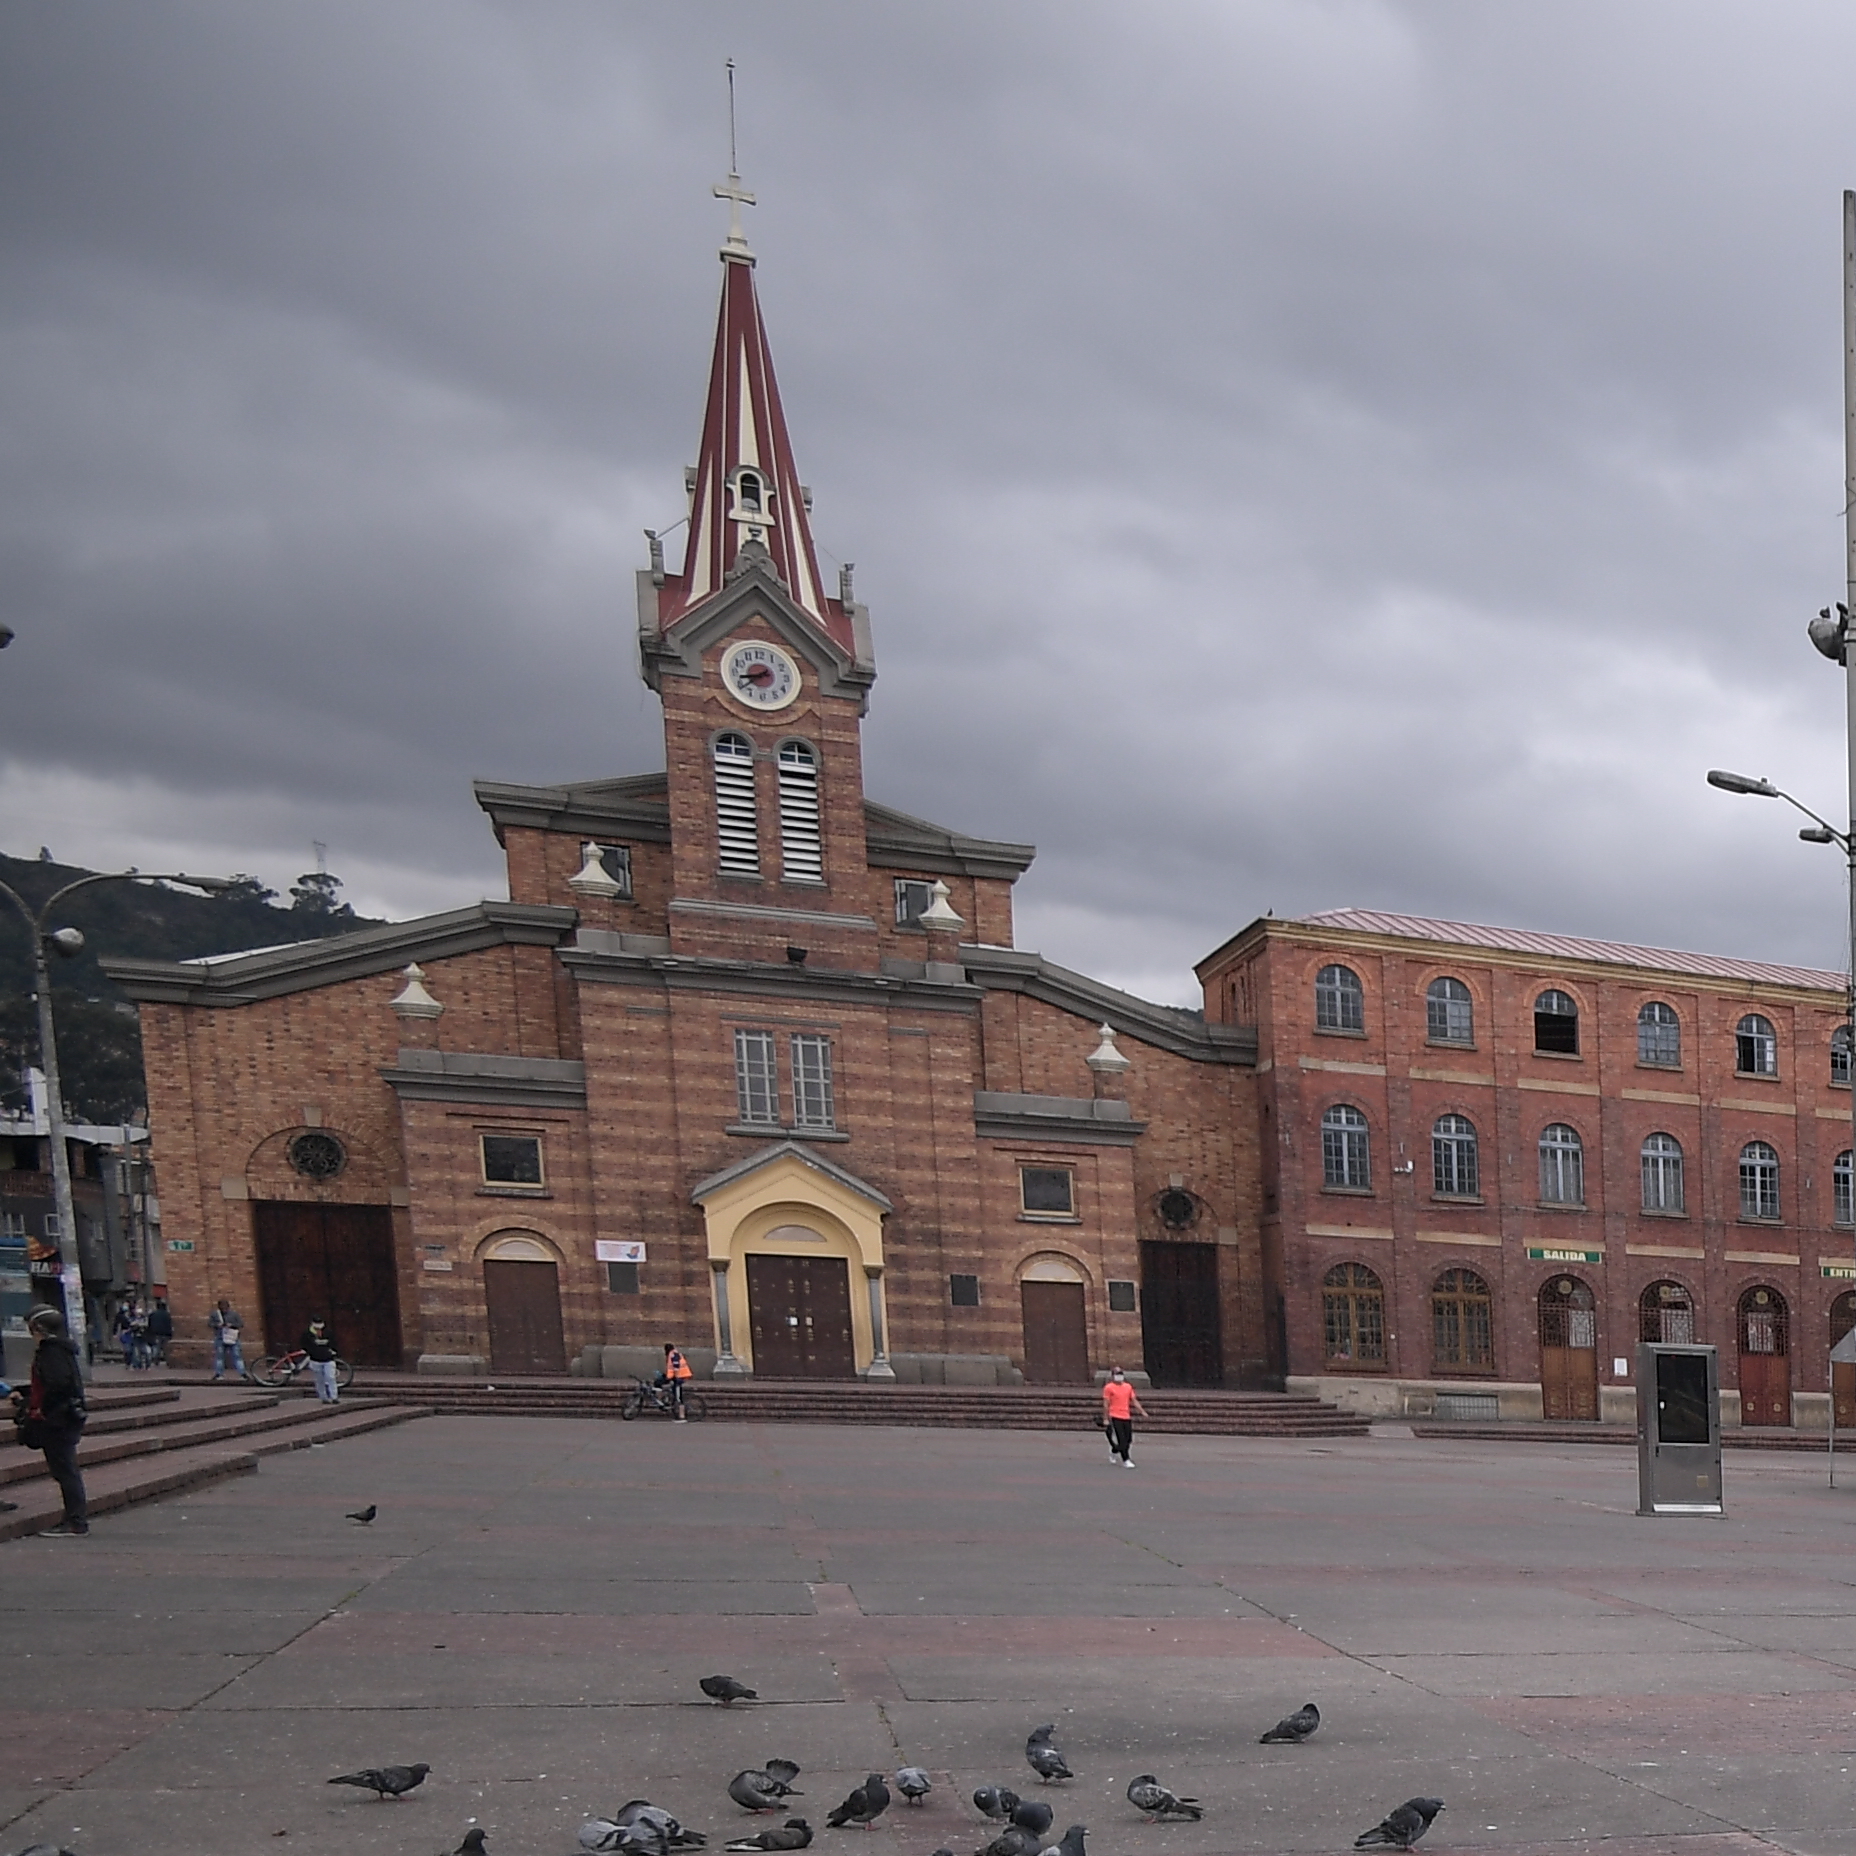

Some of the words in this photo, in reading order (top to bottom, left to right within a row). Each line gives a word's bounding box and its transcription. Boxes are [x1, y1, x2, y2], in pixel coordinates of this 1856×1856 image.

[745, 652, 752, 661] 11
[755, 651, 765, 660] 12
[735, 658, 746, 668] 10
[778, 663, 784, 672] 2
[746, 687, 753, 697] 7
[772, 690, 779, 700] 5
[1543, 1250, 1587, 1261] SALIDA
